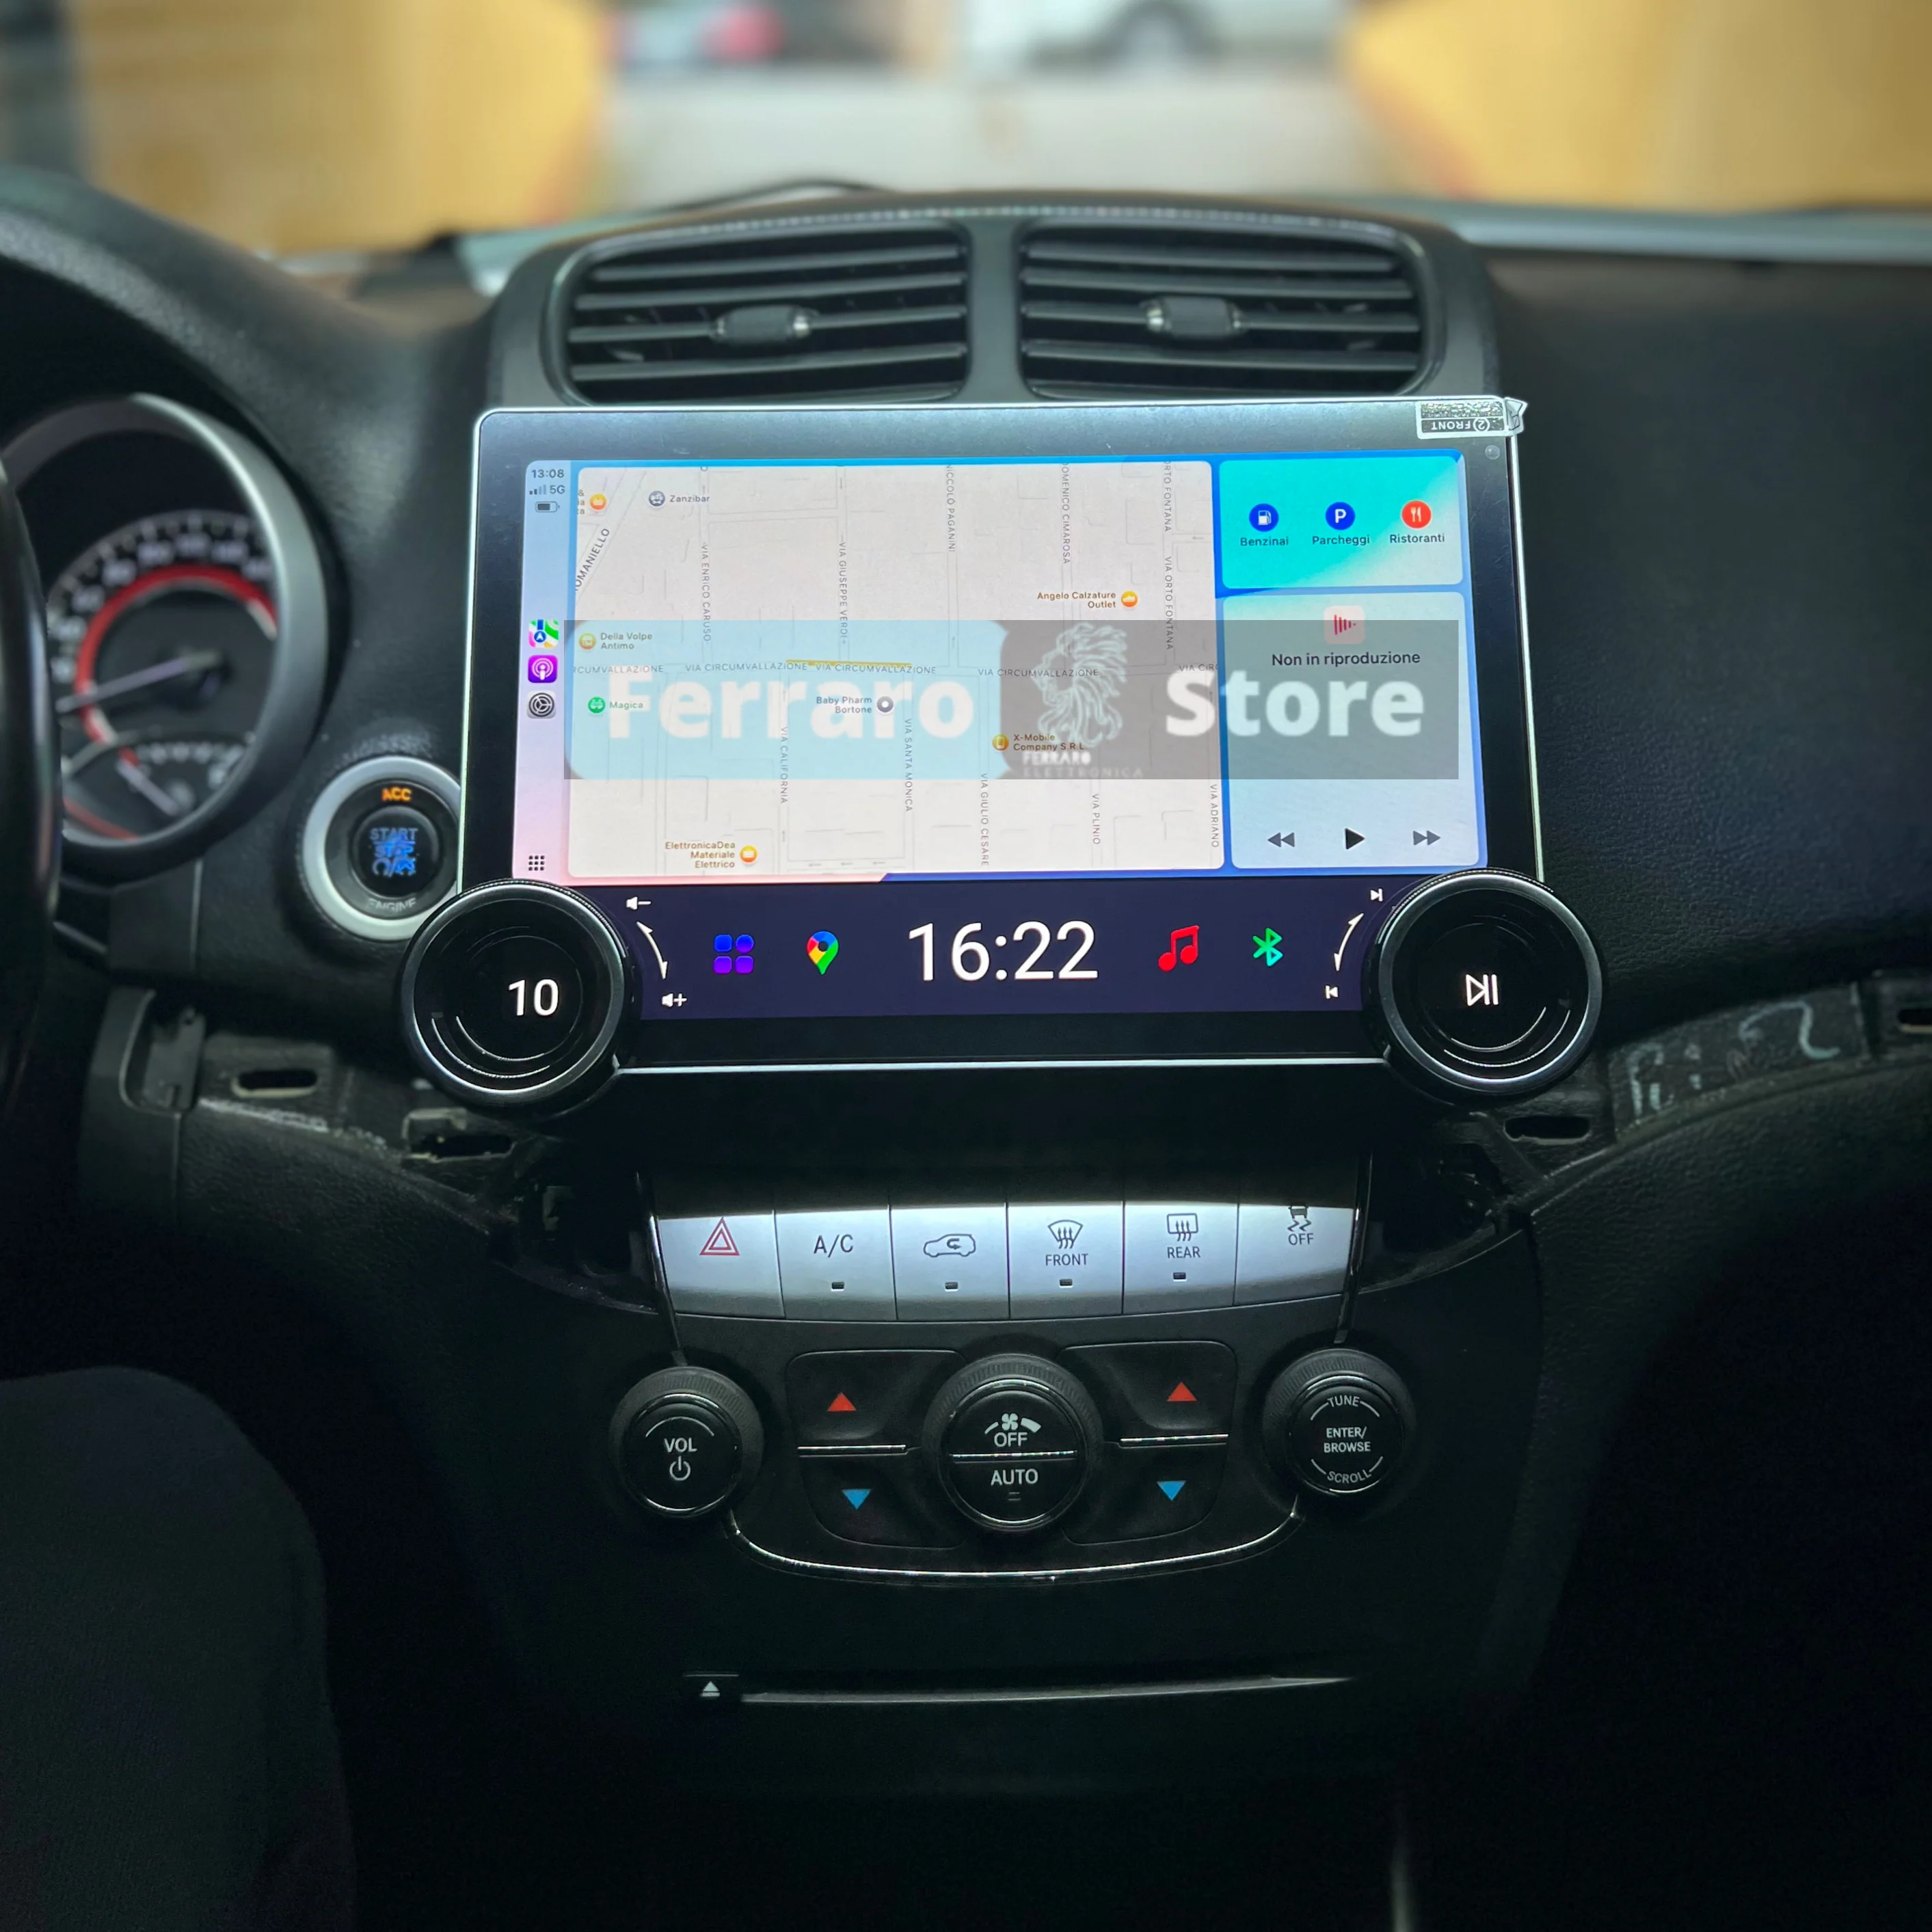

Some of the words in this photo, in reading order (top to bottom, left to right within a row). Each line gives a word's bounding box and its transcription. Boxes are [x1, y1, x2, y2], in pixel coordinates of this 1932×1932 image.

[1431, 421, 1471, 430] FRONT
[531, 469, 565, 479] 13:08
[550, 485, 565, 494] 5G
[669, 495, 710, 503] Zanzibar
[1164, 487, 1172, 532] FONTANA
[948, 509, 956, 552] PAGANINI
[1062, 514, 1071, 563] CIMAROSA
[1240, 536, 1289, 546] Benzinai
[1312, 535, 1370, 546] Parcheggi
[1390, 533, 1445, 543] Ristoranti
[701, 563, 710, 598] ENRICO
[1037, 592, 1069, 600] Angelo
[703, 602, 711, 641] CARUSO
[840, 610, 848, 637] VERDI
[1165, 605, 1173, 650] FONTANA
[626, 632, 652, 641] Volpe
[1272, 654, 1302, 666] Non
[1306, 653, 1319, 665] in
[1324, 651, 1421, 667] riproduzione
[705, 662, 807, 671] CIRCUMVALLAZIONE
[835, 665, 937, 674] CIRCUMVALLAZIONE
[997, 669, 1098, 677] CIRCUMVALLAZIONE
[609, 701, 644, 710] Magica
[816, 697, 839, 706] Baby
[1013, 743, 1057, 751] Company
[381, 788, 412, 801] ACC
[1092, 812, 1101, 844] PLINIO
[1210, 803, 1220, 847] ADRIANO
[370, 828, 418, 840] START
[665, 841, 736, 849] ElettronicaDea
[909, 920, 1099, 982] 16:22
[508, 979, 559, 1016] 10
[1288, 1233, 1314, 1246] OFF
[814, 1234, 853, 1258] A/C
[1167, 1247, 1200, 1259] REAR
[1045, 1253, 1088, 1266] FRONT
[1328, 1395, 1360, 1407] TUNE
[1326, 1426, 1367, 1438] ENTER/
[665, 1438, 697, 1453] VOL
[994, 1432, 1028, 1447] OFF
[1324, 1441, 1370, 1453] BROWSE
[991, 1469, 1038, 1486] AUTO
[1327, 1470, 1371, 1484] SCROLL
